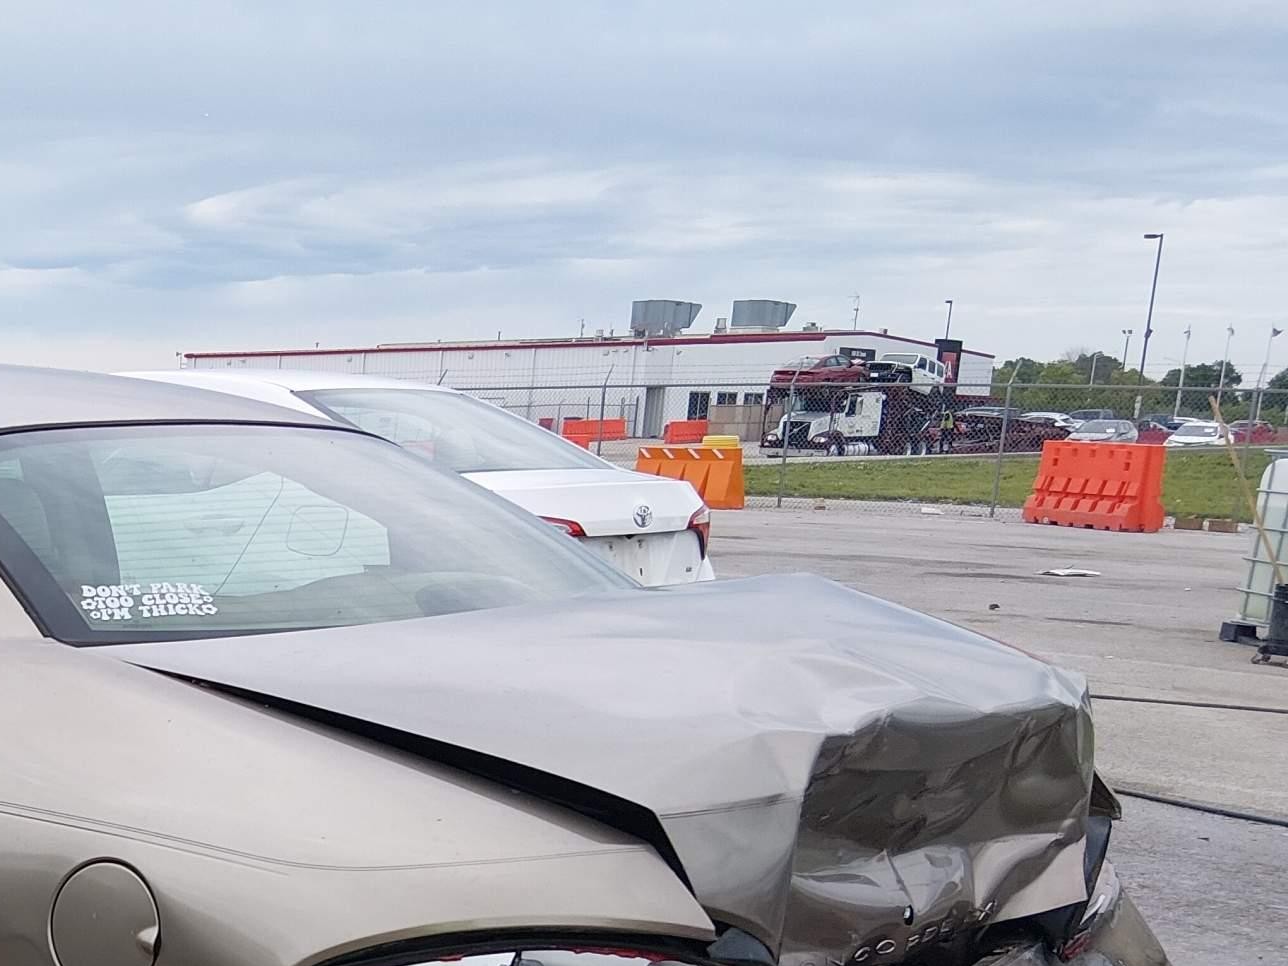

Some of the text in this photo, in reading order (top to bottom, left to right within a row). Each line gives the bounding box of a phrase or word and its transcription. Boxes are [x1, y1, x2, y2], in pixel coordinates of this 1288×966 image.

[80, 582, 210, 597] DON'T PARK
[93, 593, 204, 609] TOO CLOSE
[100, 604, 206, 620] I'M THICK
